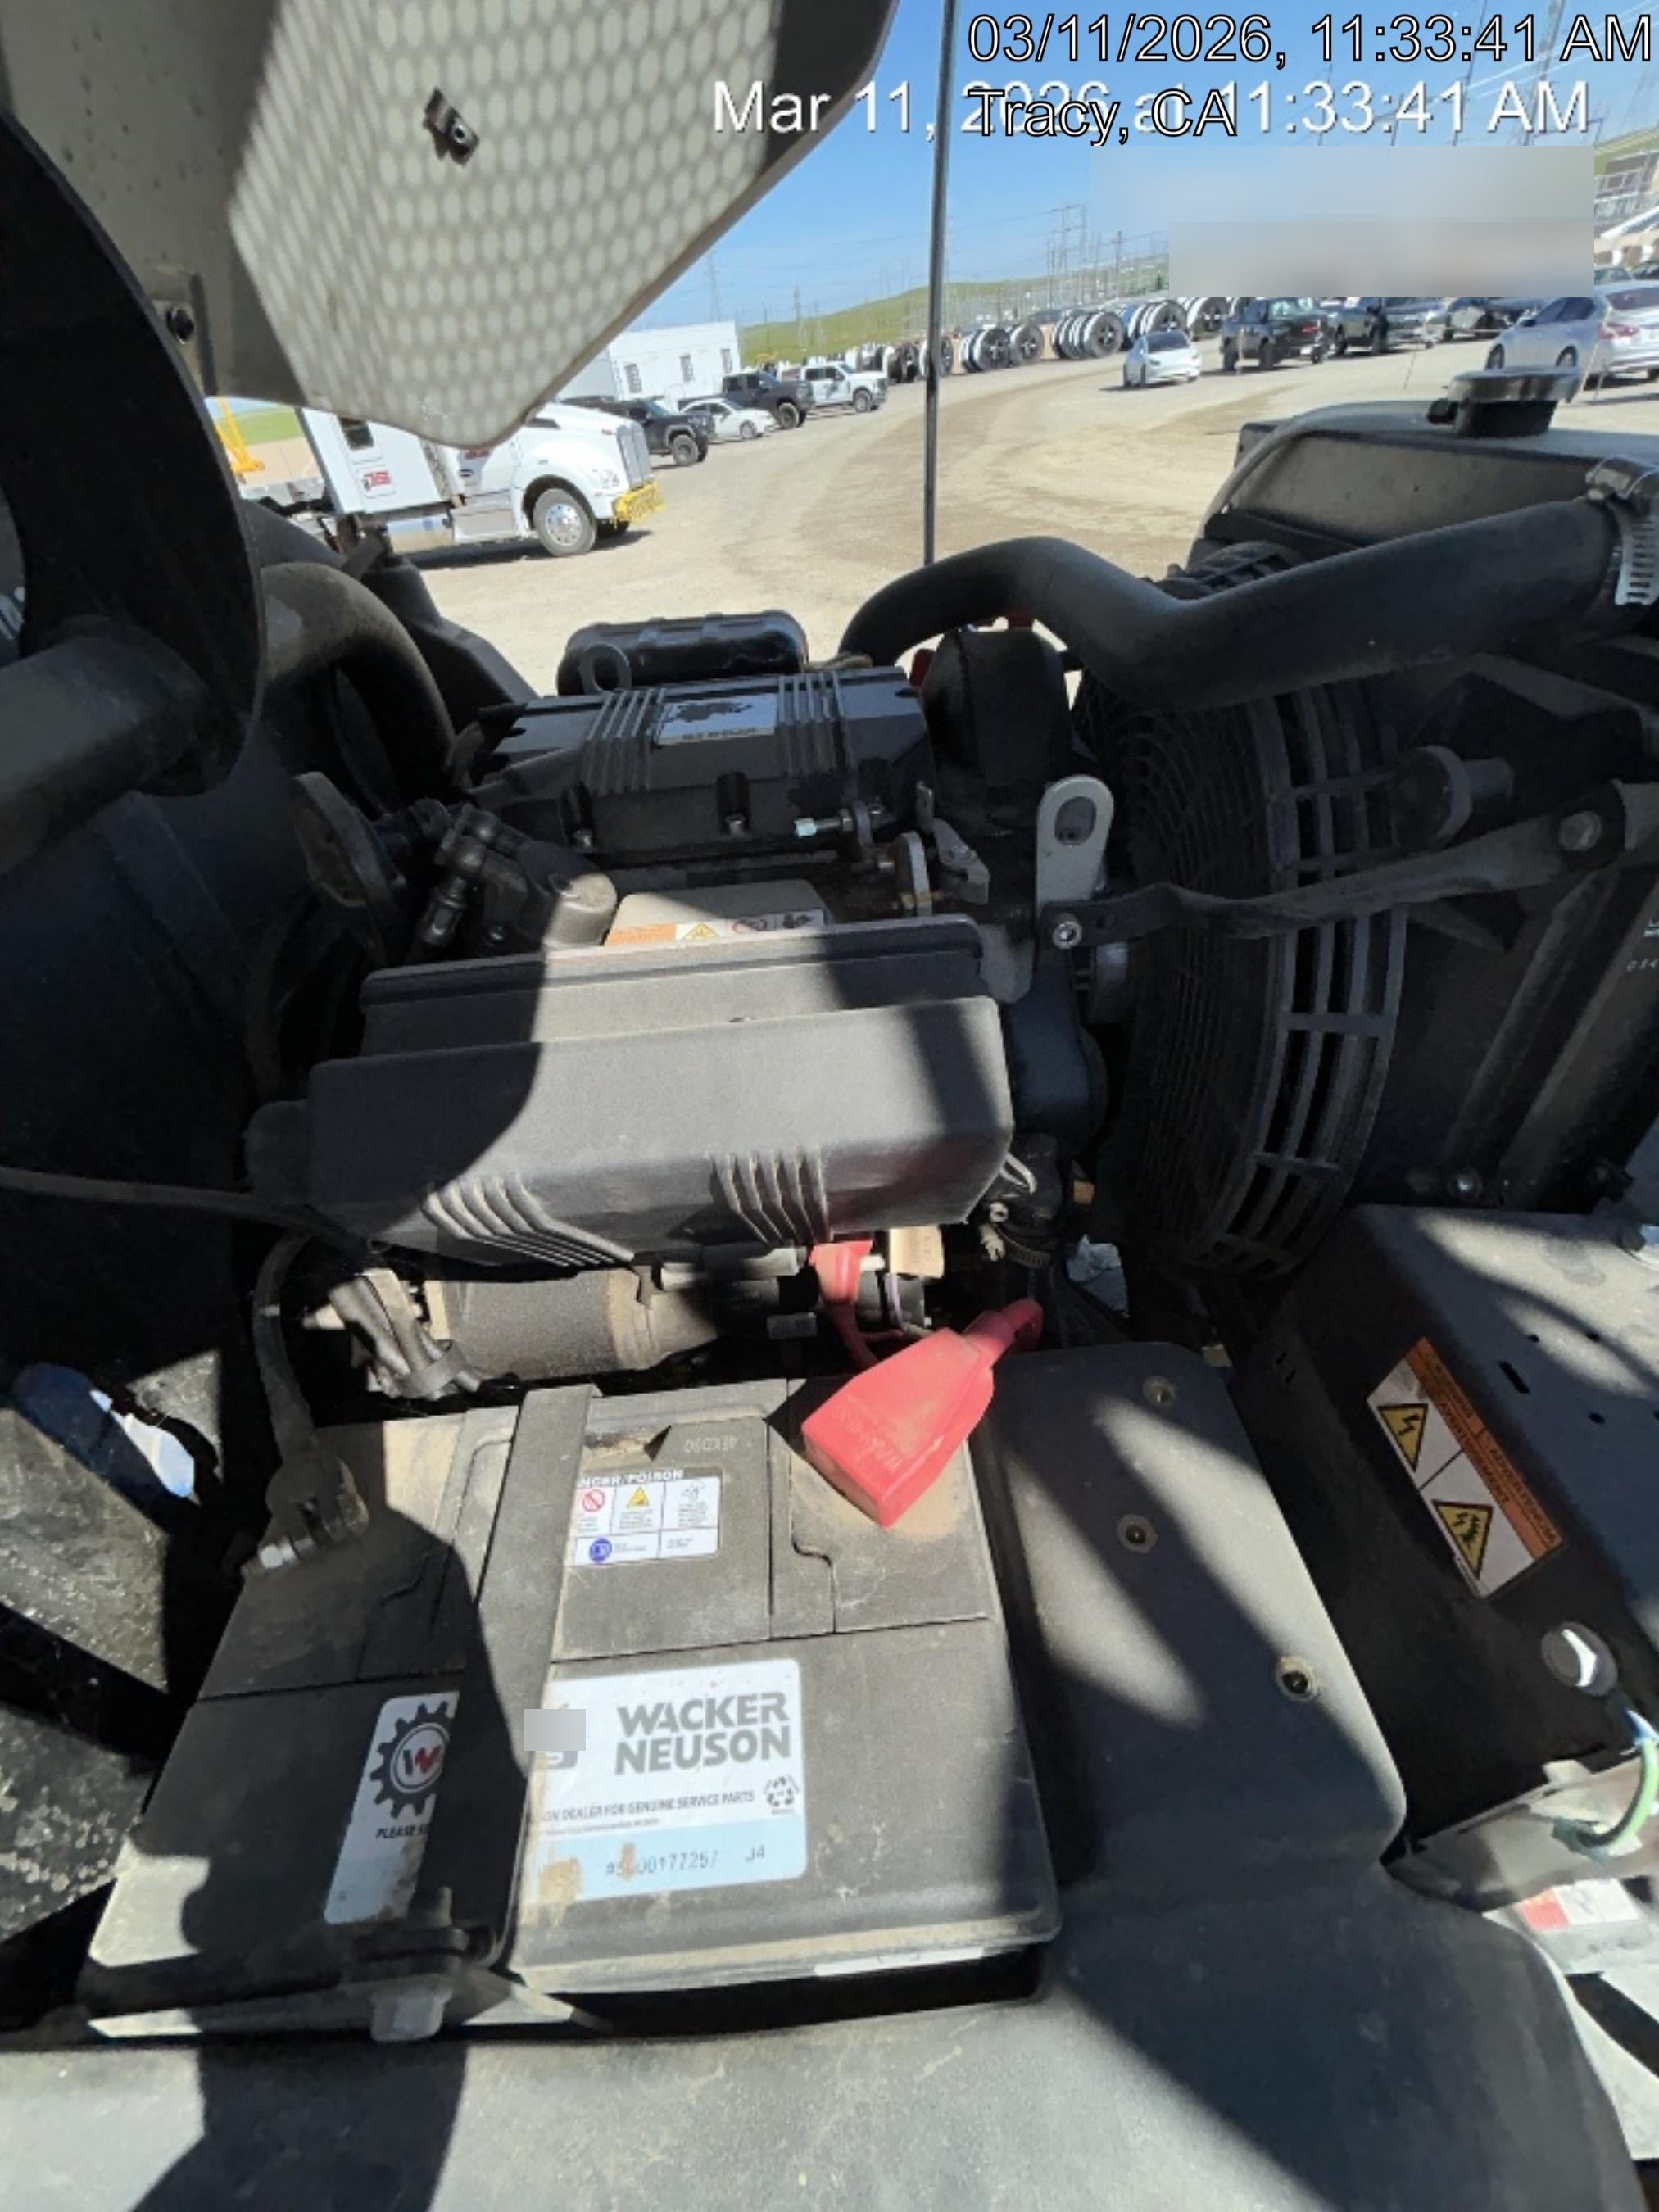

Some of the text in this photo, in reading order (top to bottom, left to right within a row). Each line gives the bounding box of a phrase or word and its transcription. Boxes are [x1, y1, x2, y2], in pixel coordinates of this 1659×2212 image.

[617, 1690, 790, 1738] WACKER
[614, 1725, 790, 1775] NEUSON
[603, 1802, 625, 1817] FOR
[677, 1793, 718, 1810] SERVICE
[722, 1789, 755, 1805] PARTS
